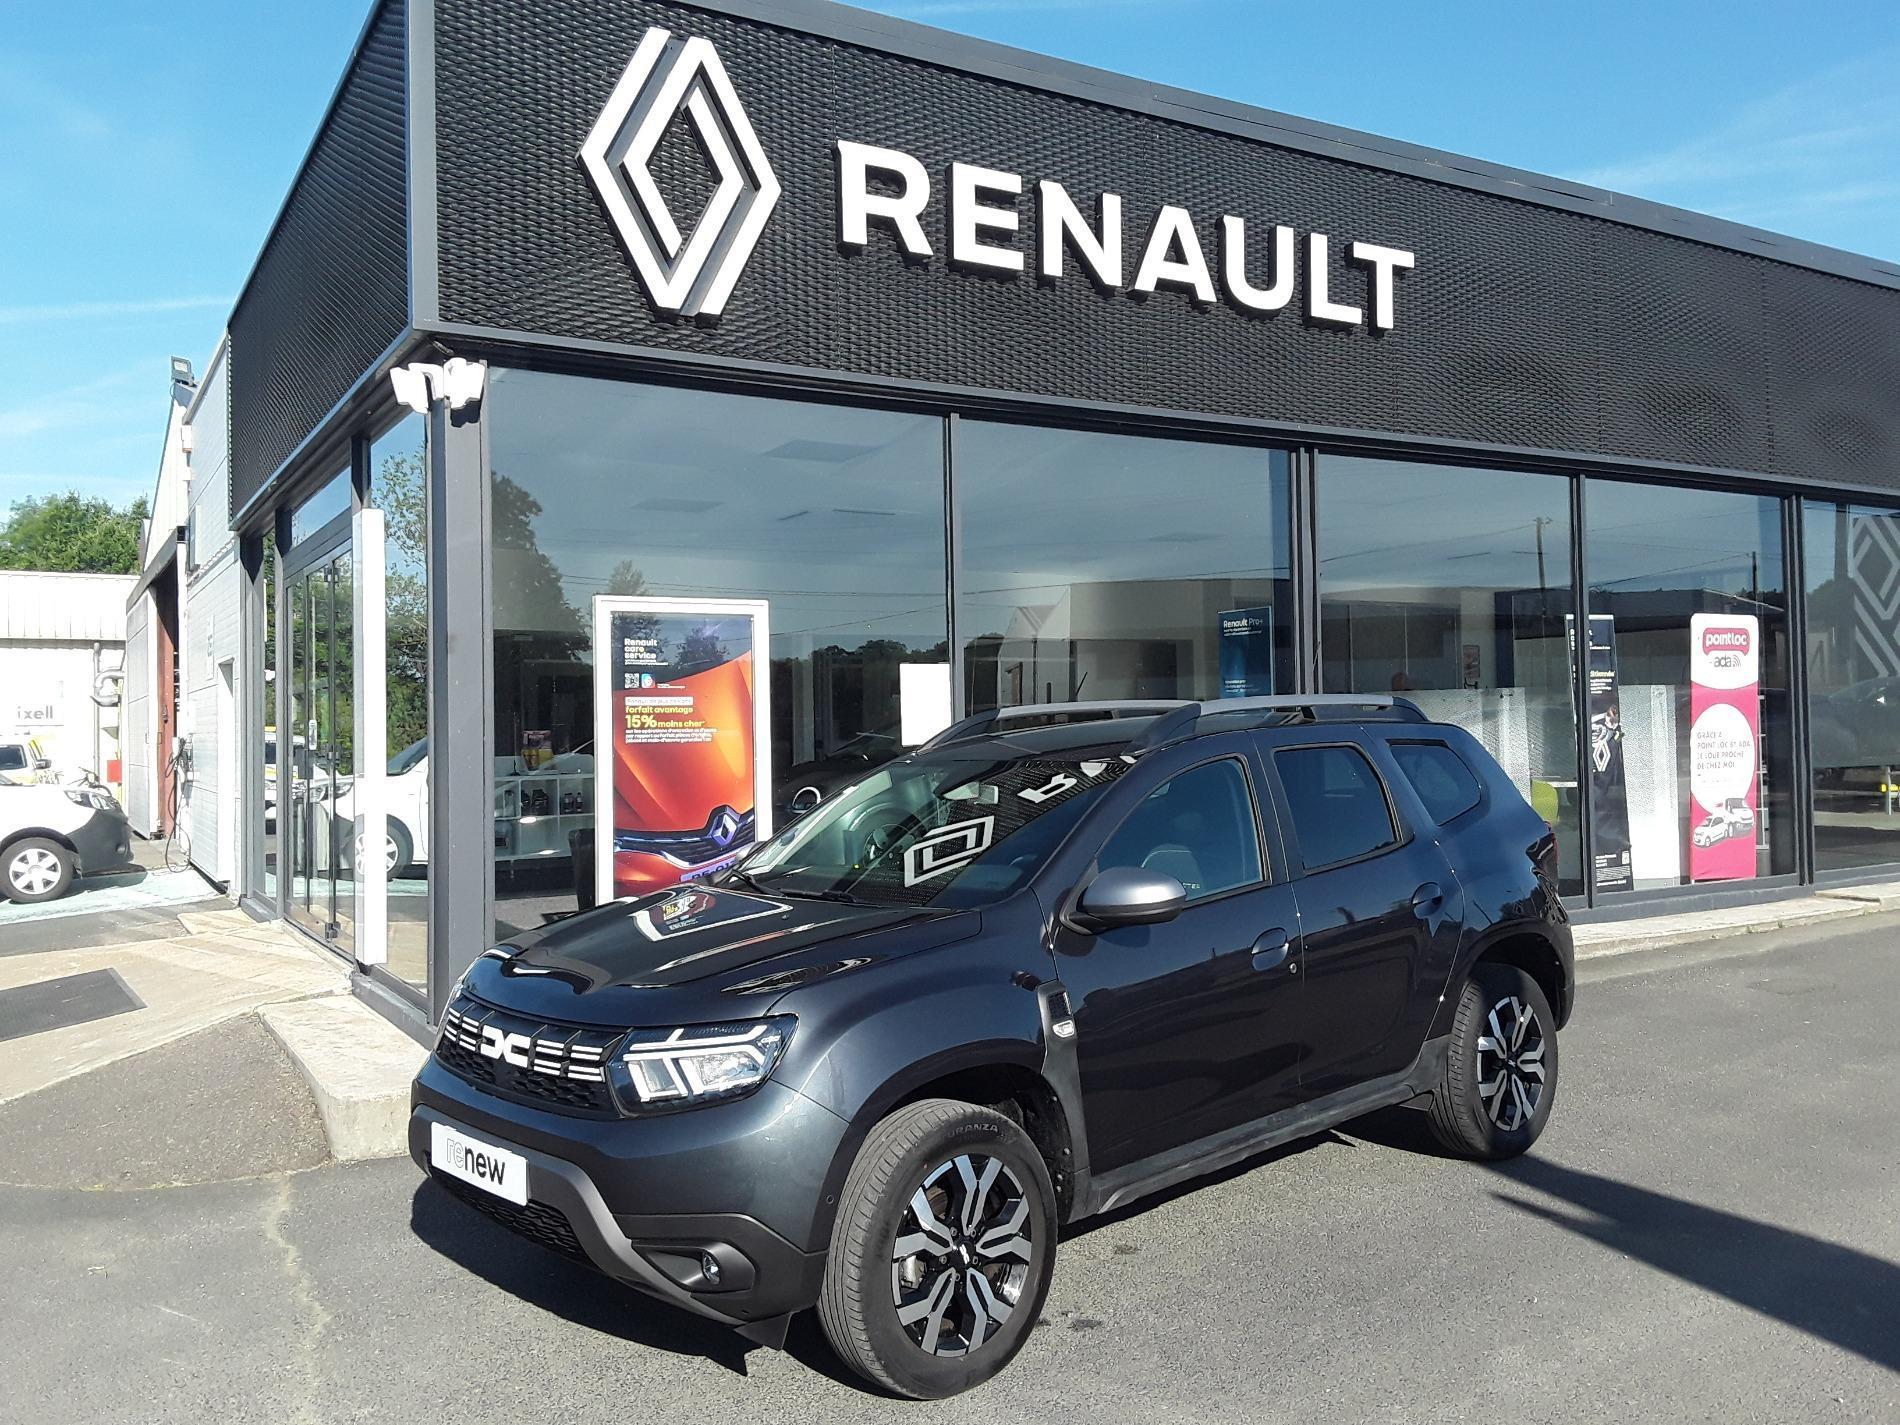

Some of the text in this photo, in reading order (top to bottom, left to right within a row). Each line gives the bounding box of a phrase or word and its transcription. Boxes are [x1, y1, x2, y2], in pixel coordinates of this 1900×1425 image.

[836, 138, 1415, 331] RENAULT
[1223, 617, 1263, 628] Renault Pro+
[624, 638, 658, 646] Renault
[1714, 654, 1732, 668] ada
[17, 704, 54, 720] ixell
[625, 705, 694, 715] forfait avantage
[625, 714, 657, 729] 15%
[657, 720, 682, 728] moins
[446, 1137, 506, 1186] renew
